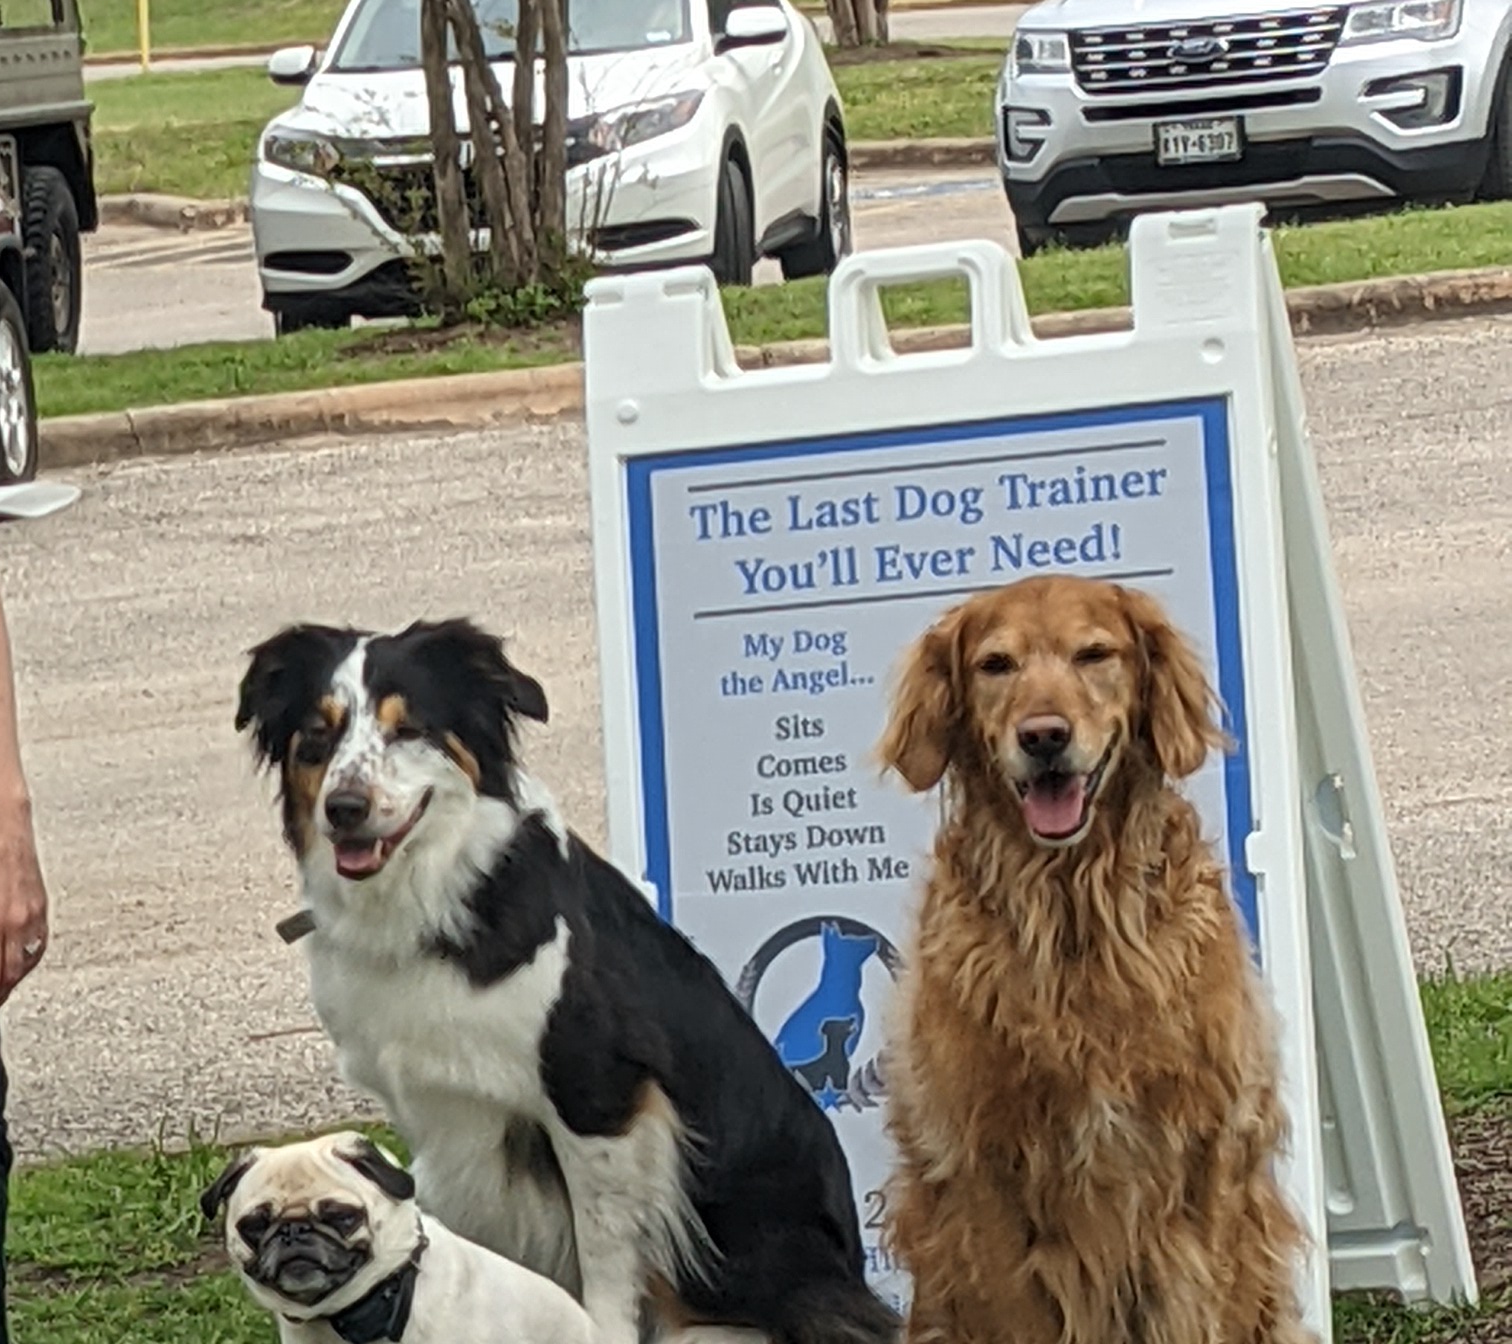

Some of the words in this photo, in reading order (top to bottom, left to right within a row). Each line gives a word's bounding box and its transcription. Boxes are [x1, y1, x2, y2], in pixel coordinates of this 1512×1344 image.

[689, 500, 773, 540] The
[787, 491, 880, 532] Last
[894, 484, 984, 525] Dog
[998, 465, 1168, 511] Trainer
[734, 545, 860, 595] You'll
[874, 544, 976, 583] Ever
[990, 521, 1122, 572] Need!
[743, 632, 785, 661] My
[792, 629, 848, 656] Dog
[720, 670, 764, 697] the
[771, 660, 875, 695] Angel...
[774, 713, 825, 741] Sits
[756, 753, 848, 779] Comes
[750, 793, 775, 817] Is
[782, 785, 858, 818] Quiet
[726, 830, 797, 858] Stays
[805, 824, 886, 850] Down
[705, 864, 787, 894] Walks
[793, 857, 859, 887] With
[867, 855, 910, 882] Me
